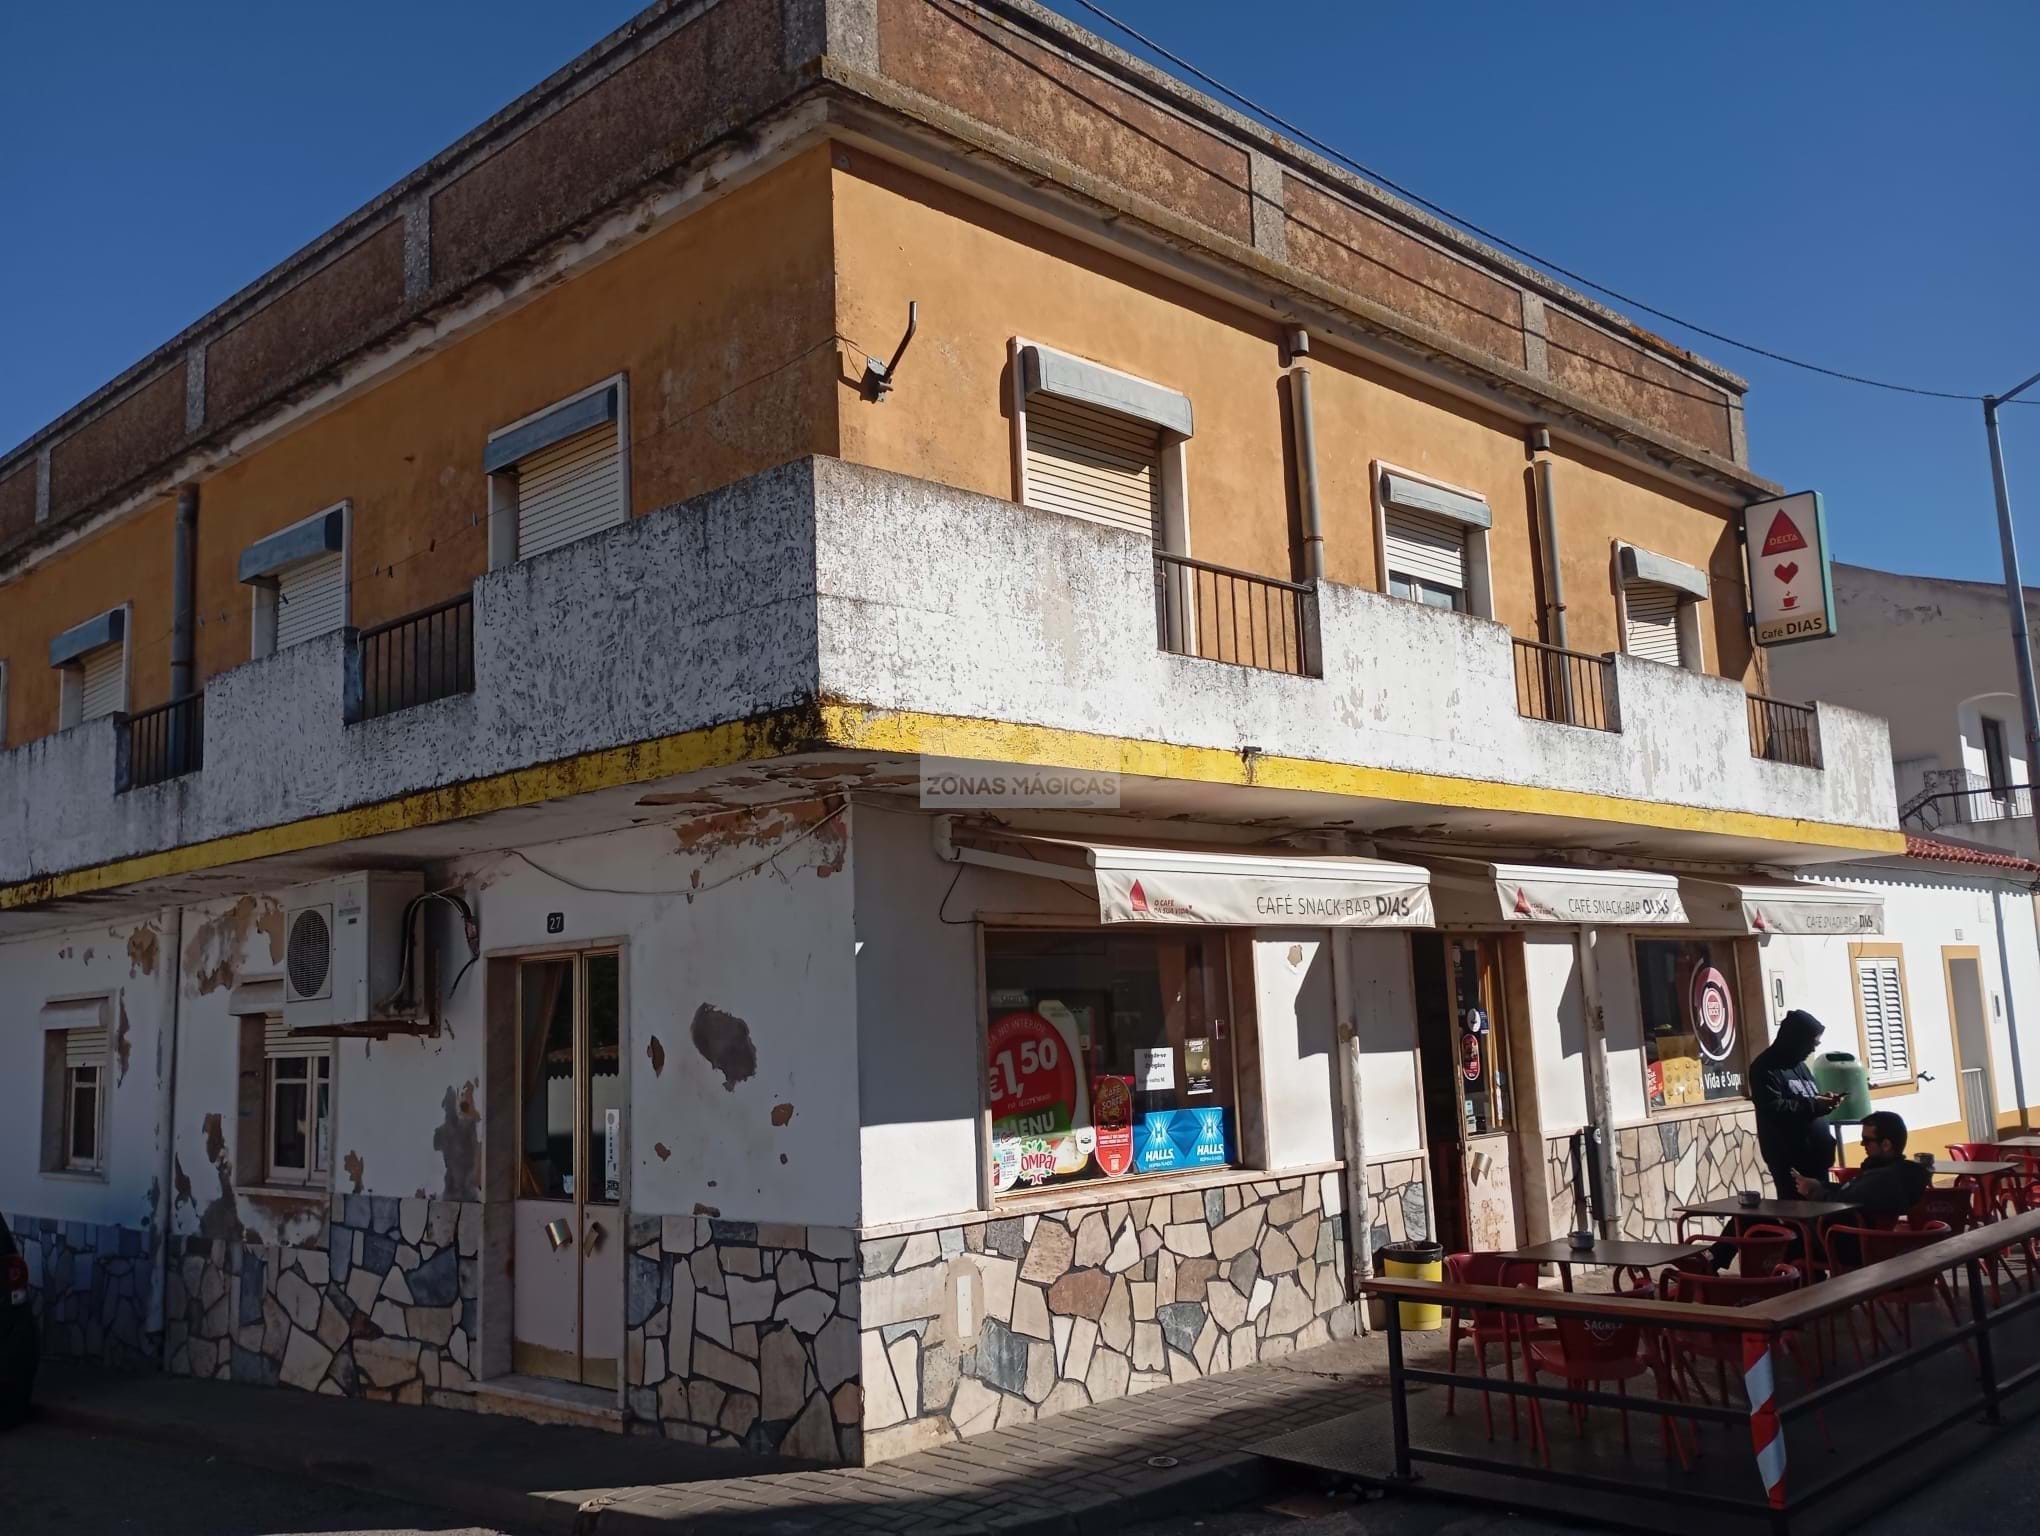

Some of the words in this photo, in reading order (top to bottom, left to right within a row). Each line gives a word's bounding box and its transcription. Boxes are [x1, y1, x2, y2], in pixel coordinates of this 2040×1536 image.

[1769, 533, 1799, 546] DELTA
[1761, 627, 1784, 640] Café
[1786, 617, 1823, 635] DIAS
[1256, 893, 1295, 915] CAFÉ
[1298, 897, 1374, 917] SNACK-BAR
[1375, 896, 1411, 917] DIAS
[1568, 896, 1593, 914] CAFÉ
[550, 916, 561, 930] 27
[1704, 1072, 1721, 1090] Vida
[1721, 1071, 1726, 1088] é
[1145, 1148, 1175, 1162] HALLS
[1197, 1143, 1224, 1156] HALLS
